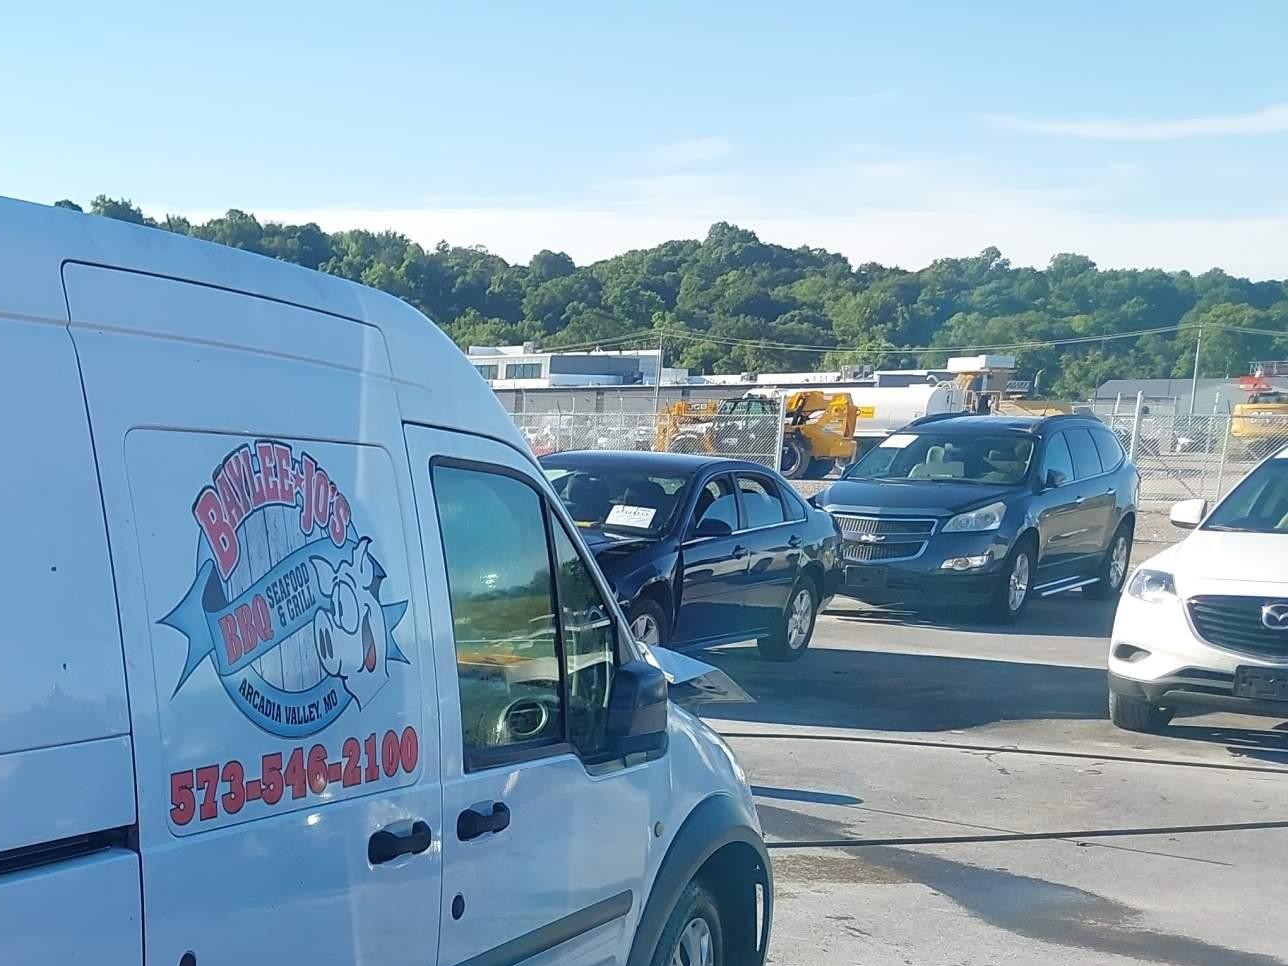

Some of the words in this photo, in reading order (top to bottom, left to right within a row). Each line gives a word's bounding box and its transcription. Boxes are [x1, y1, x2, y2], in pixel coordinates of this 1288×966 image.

[193, 440, 296, 581] BAYLEE
[266, 562, 310, 609] SEAFOOD
[277, 604, 287, 627] &
[286, 584, 316, 620] GRILL
[218, 593, 274, 666] BBQ
[238, 678, 281, 722] ARCADIA
[285, 701, 322, 725] VALLEY,
[323, 689, 338, 713] MO
[170, 726, 418, 825] 573-546-2100
